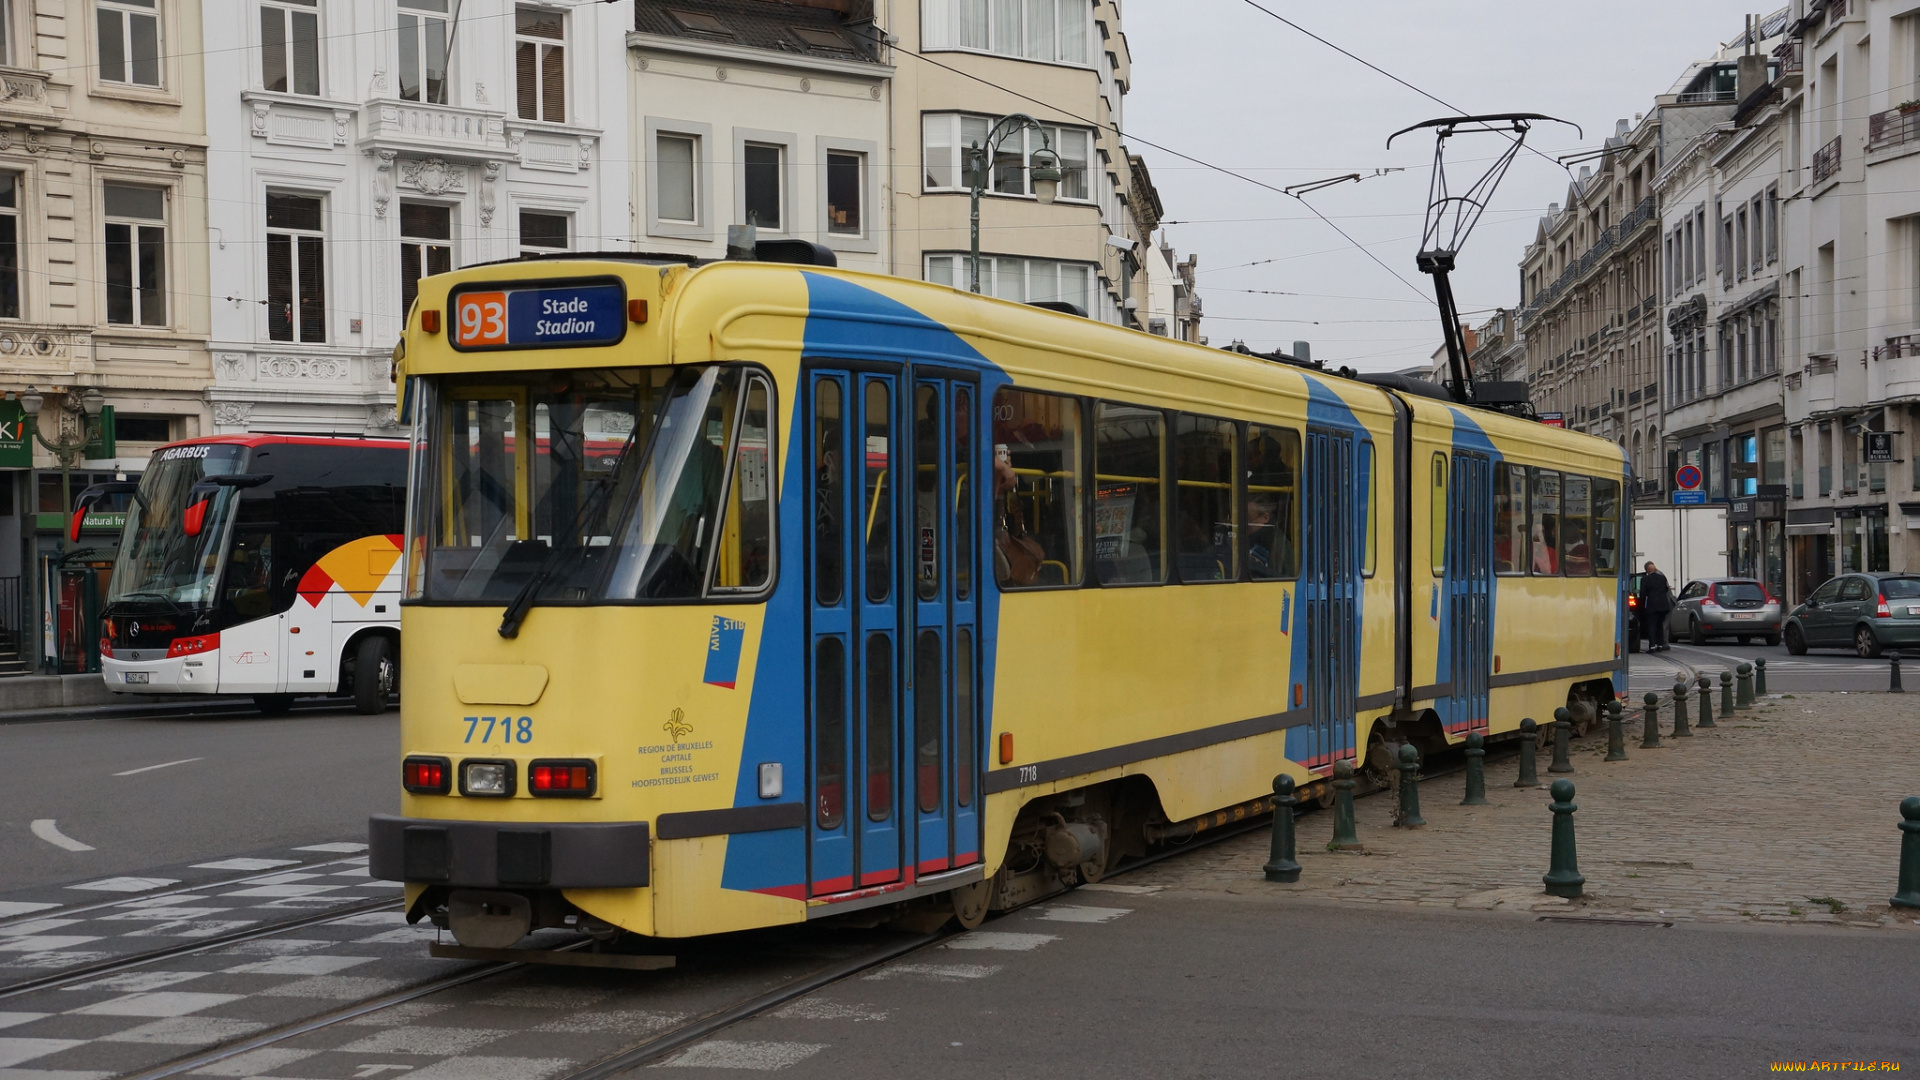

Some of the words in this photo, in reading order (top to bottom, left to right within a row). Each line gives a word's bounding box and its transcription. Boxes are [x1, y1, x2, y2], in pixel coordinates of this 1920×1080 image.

[543, 297, 588, 315] Stade
[461, 302, 504, 340] 93
[535, 318, 595, 336] Stadion
[160, 446, 210, 462] AGARBUS
[83, 517, 112, 526] Natural
[723, 619, 745, 631] STIB
[711, 617, 720, 651] MIVB
[463, 716, 533, 744] 7718
[638, 745, 665, 754] REGION
[666, 744, 675, 752] DE
[677, 741, 713, 751] BRUXELLES
[661, 753, 692, 763] CAPITALE
[660, 765, 693, 775] BRUSSELS
[1020, 765, 1037, 783] 7718
[631, 776, 691, 788] HOOFDSTEDELIJK
[692, 773, 719, 783] GEWEST
